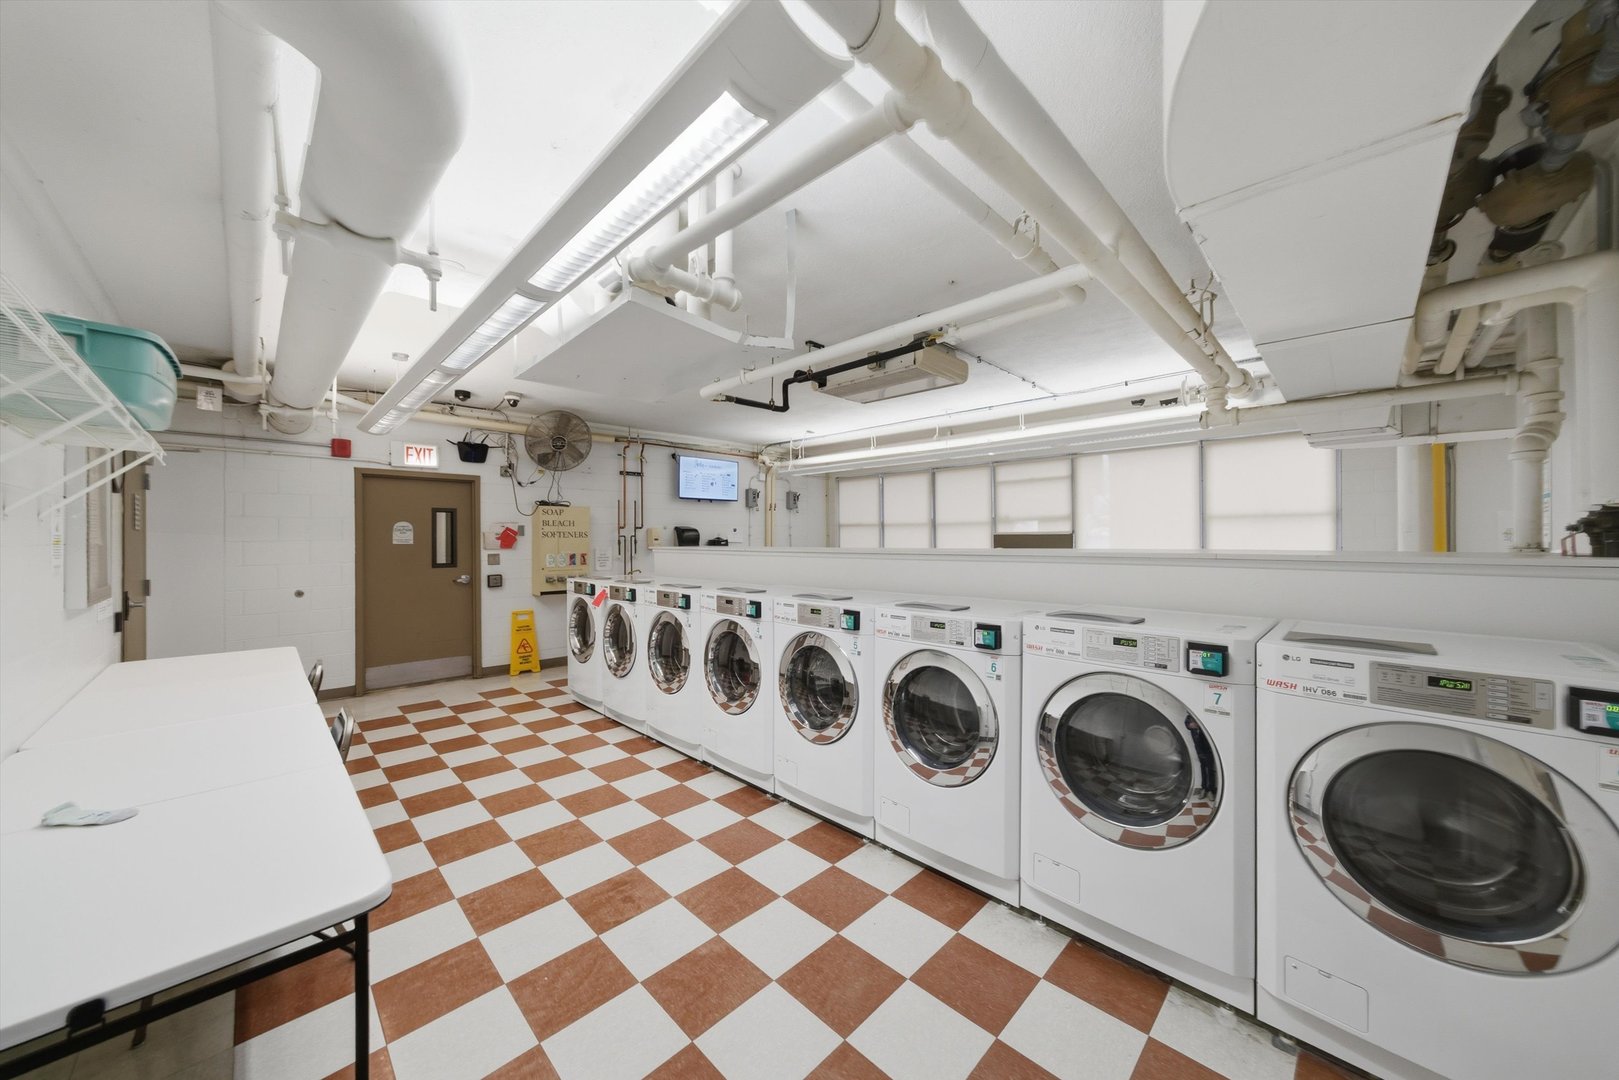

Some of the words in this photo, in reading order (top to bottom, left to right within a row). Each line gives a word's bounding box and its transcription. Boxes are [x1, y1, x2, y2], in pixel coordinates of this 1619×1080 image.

[405, 446, 434, 463] EXIT
[541, 508, 565, 516] SOAP
[542, 519, 575, 527] BLEACH
[541, 530, 589, 539] SOFTENERS
[991, 662, 997, 673] 6
[1266, 678, 1298, 690] WASH
[1213, 692, 1222, 705] 7
